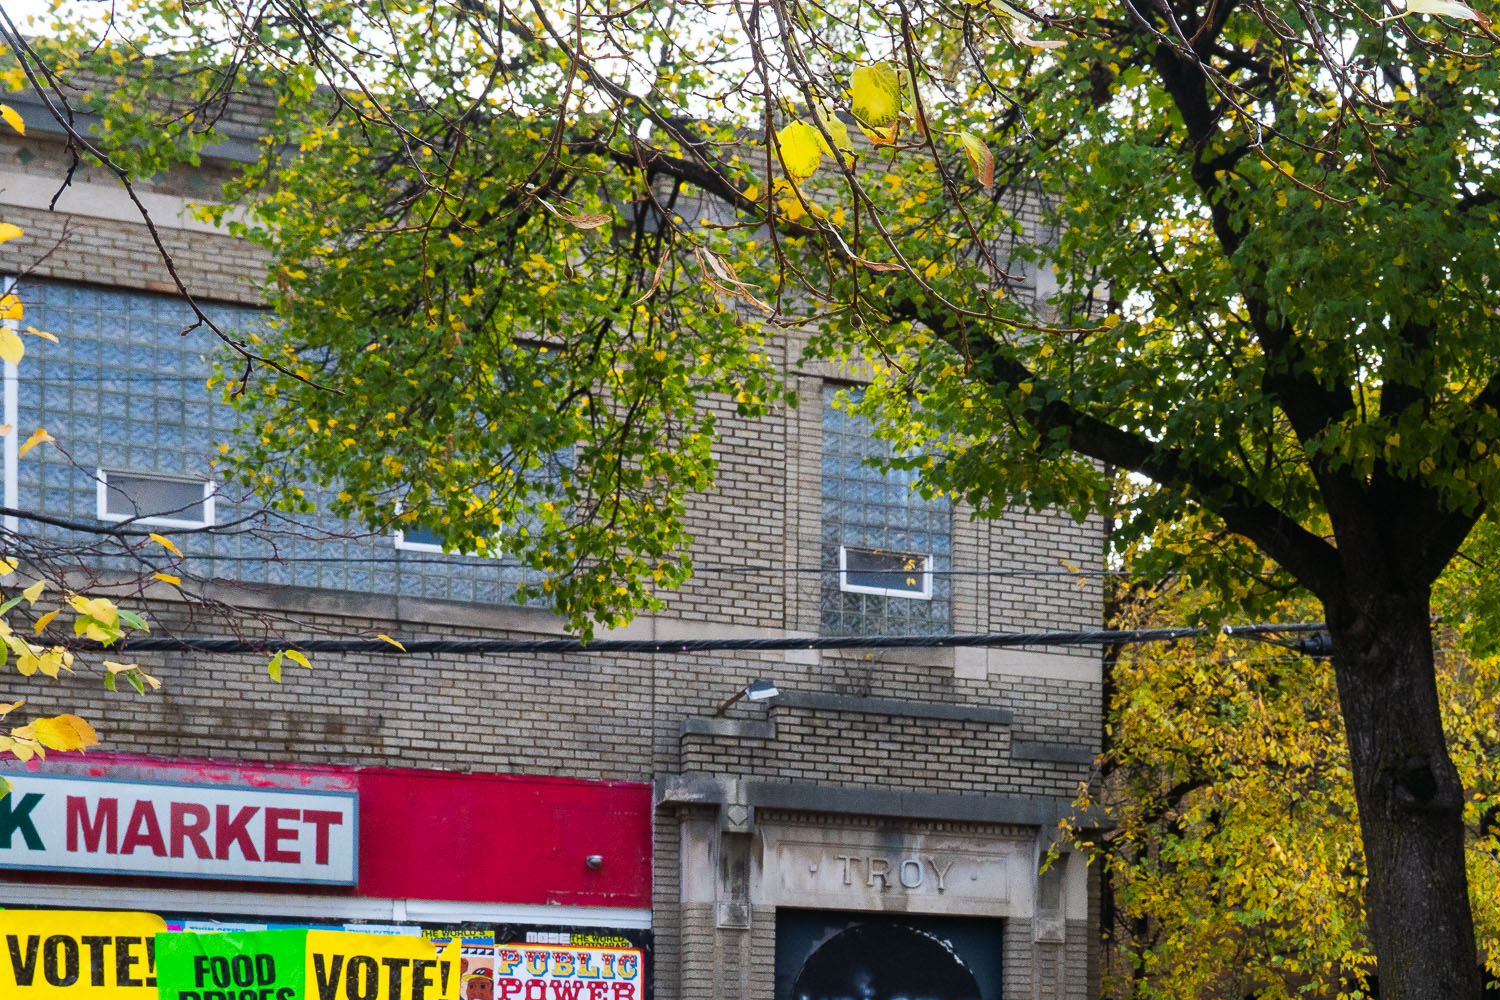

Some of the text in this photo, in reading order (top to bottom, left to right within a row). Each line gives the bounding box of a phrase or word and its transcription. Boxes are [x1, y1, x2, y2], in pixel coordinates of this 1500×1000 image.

[66, 795, 343, 866] MARKET
[836, 855, 953, 893] TROY
[6, 934, 157, 988] VOTE!
[193, 953, 277, 988] FOOD
[497, 949, 638, 980] PUBLIC
